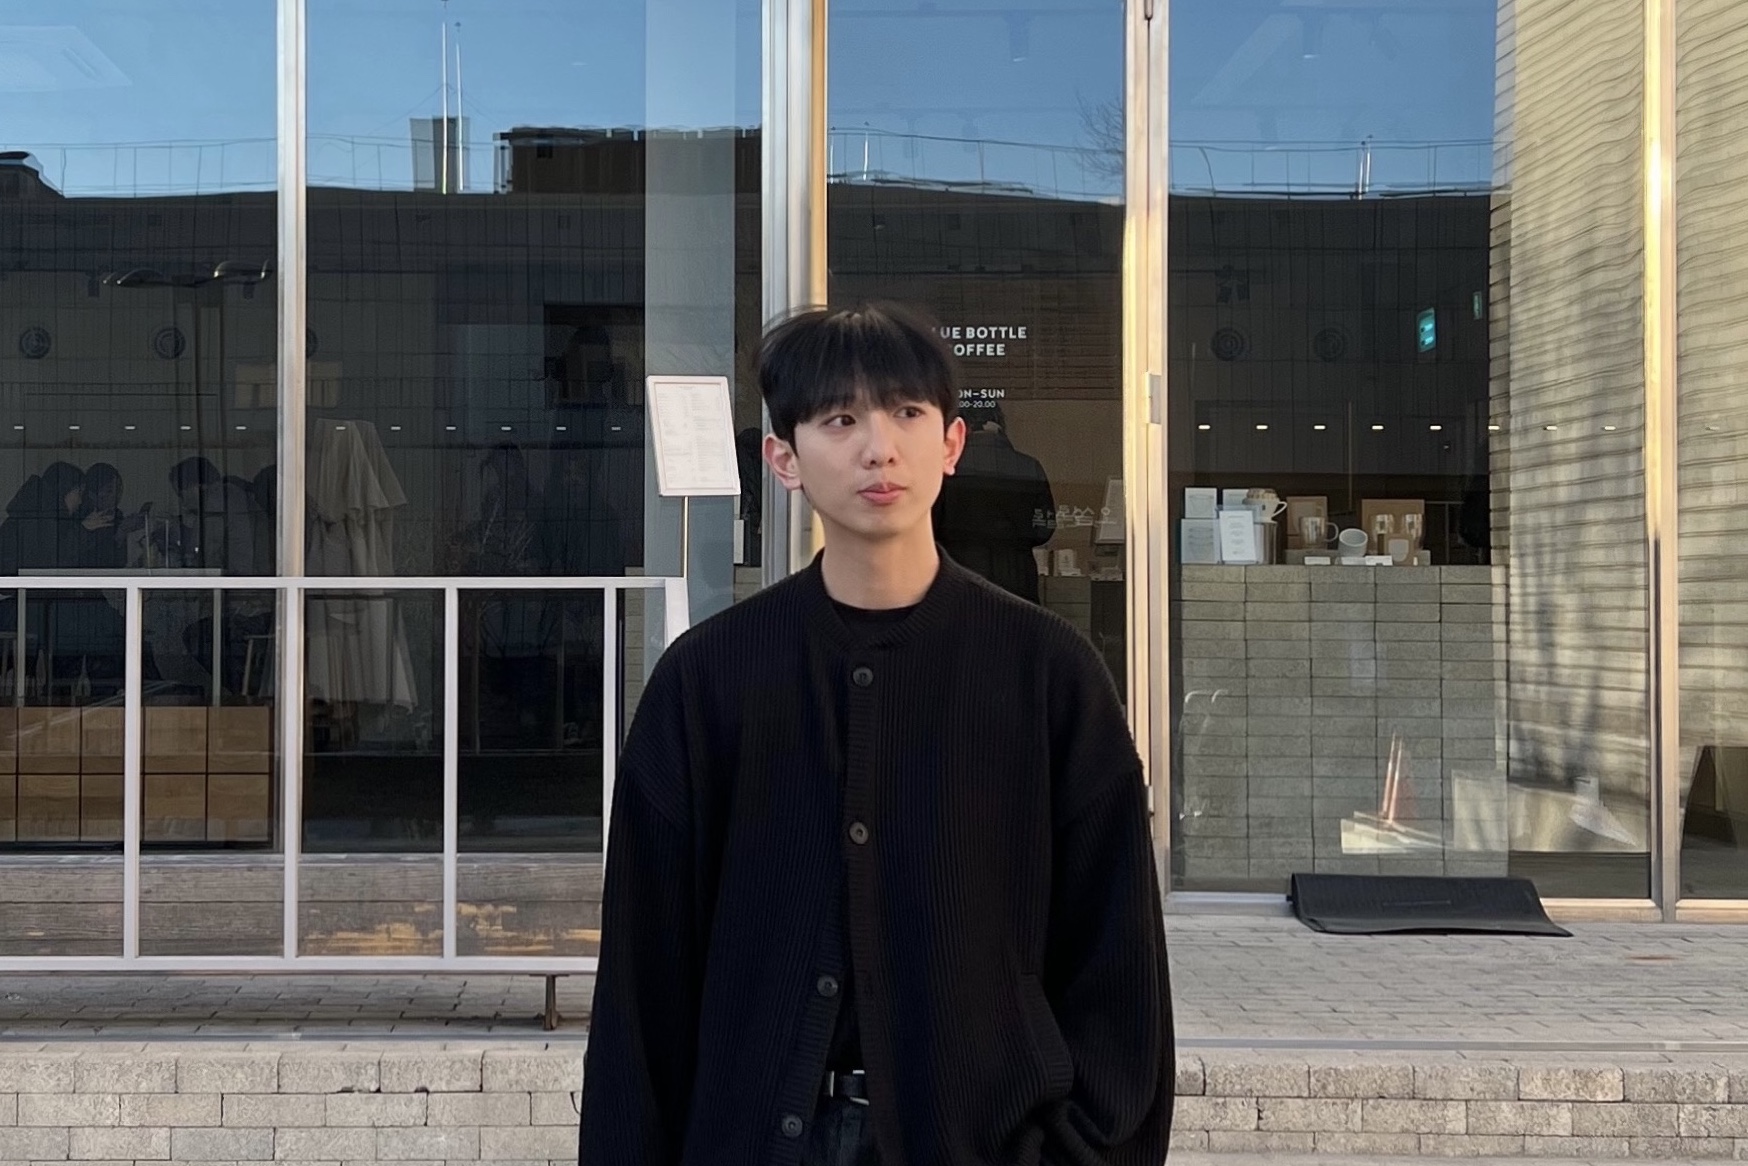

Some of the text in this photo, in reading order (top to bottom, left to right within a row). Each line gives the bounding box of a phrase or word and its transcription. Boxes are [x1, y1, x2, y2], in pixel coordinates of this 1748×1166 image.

[938, 326, 1027, 339] UE BOTTLE
[953, 343, 1006, 356] OFFEE
